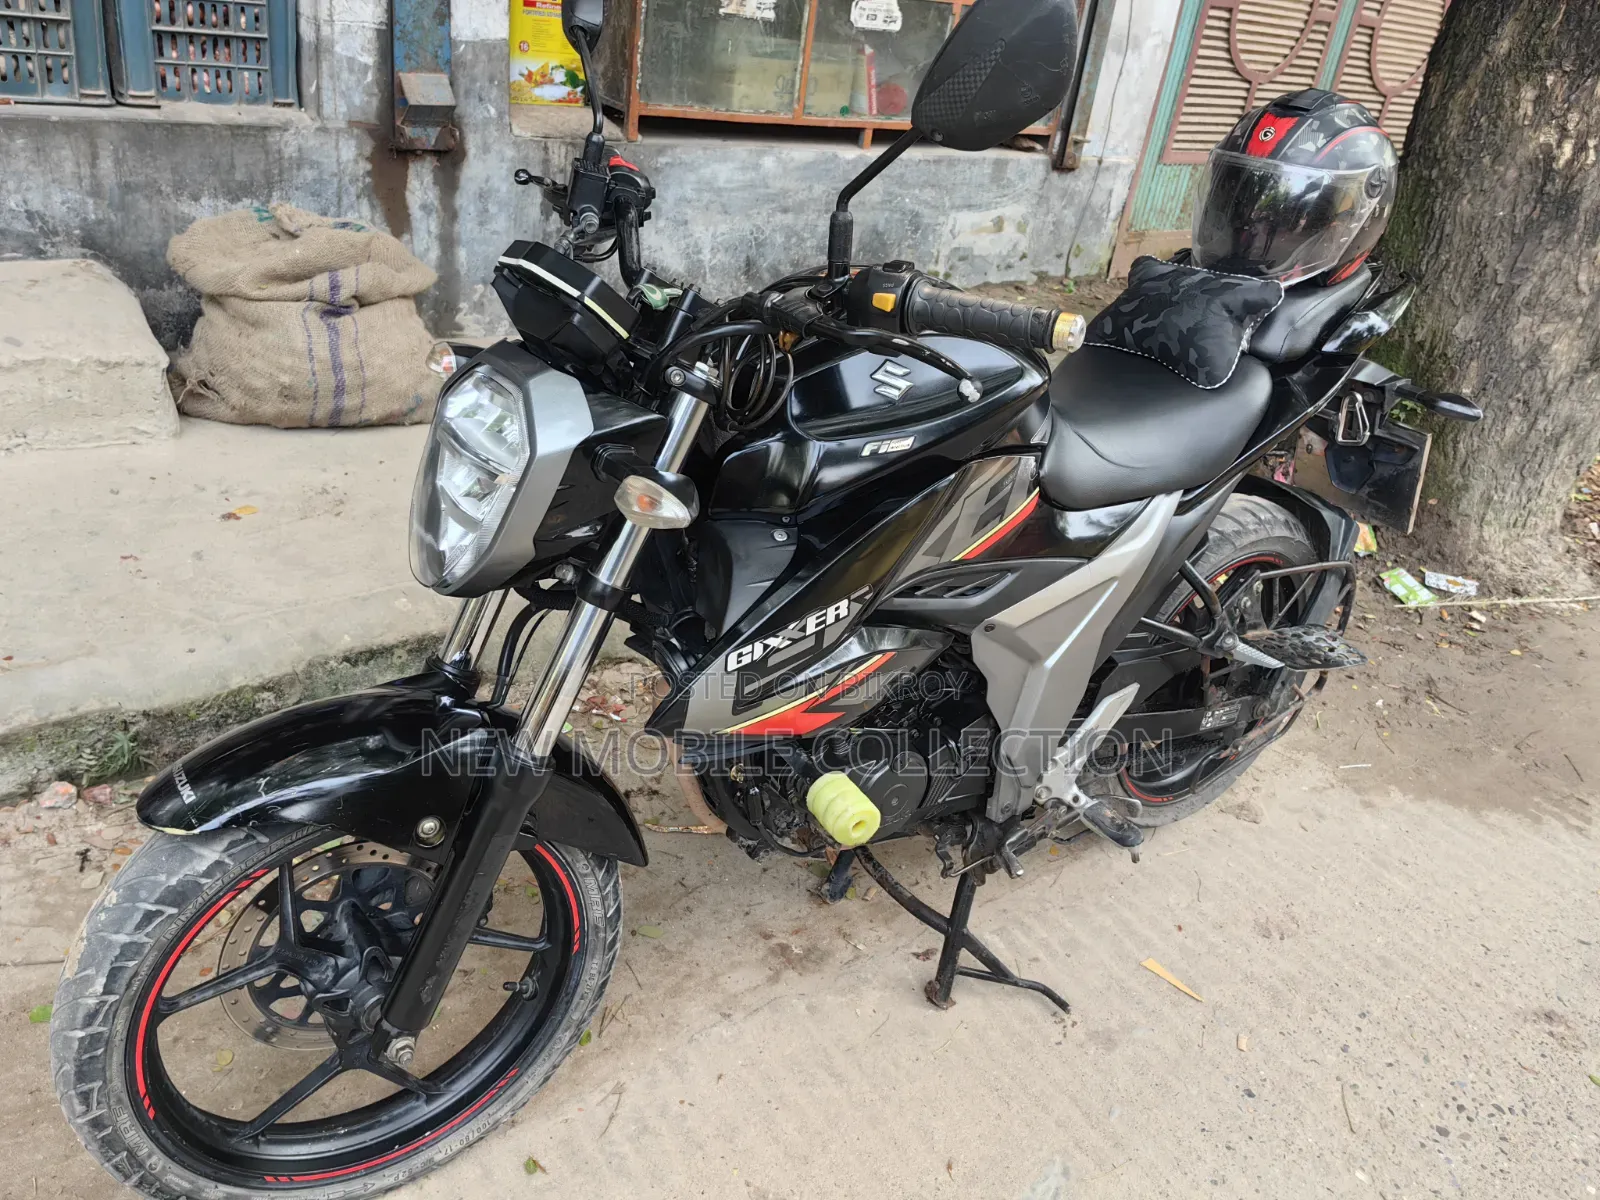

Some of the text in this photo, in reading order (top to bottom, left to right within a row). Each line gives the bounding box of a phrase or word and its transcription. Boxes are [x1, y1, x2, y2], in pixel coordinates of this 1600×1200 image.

[536, 2, 562, 10] Refine
[172, 763, 197, 805] SUZUKI
[583, 876, 606, 928] MRF
[112, 1105, 150, 1158] MRF
